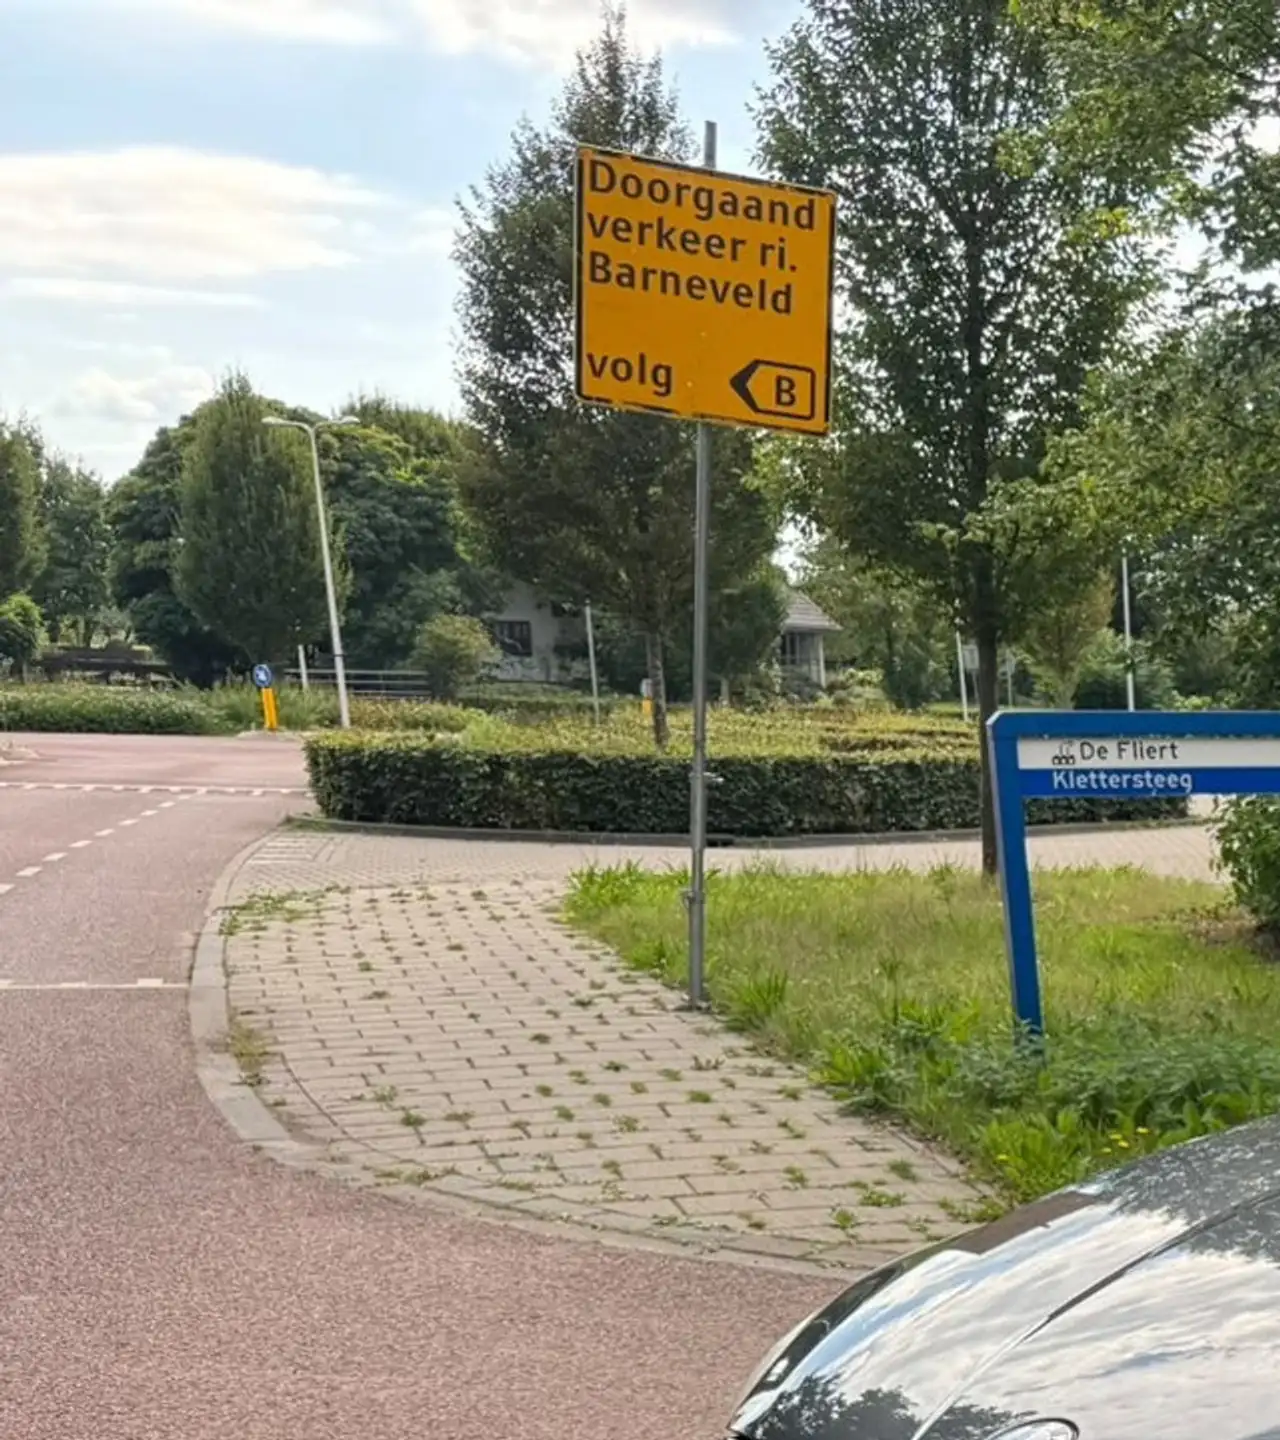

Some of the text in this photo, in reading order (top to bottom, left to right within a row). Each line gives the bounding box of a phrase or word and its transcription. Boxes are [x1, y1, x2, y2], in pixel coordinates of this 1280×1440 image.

[588, 159, 815, 230] Doorgaand
[587, 212, 797, 272] verkeer ri.
[589, 250, 792, 314] Barneveld
[586, 352, 797, 406] volg B
[1080, 738, 1178, 760] De Fliert
[1052, 770, 1192, 793] Klettersteeg
